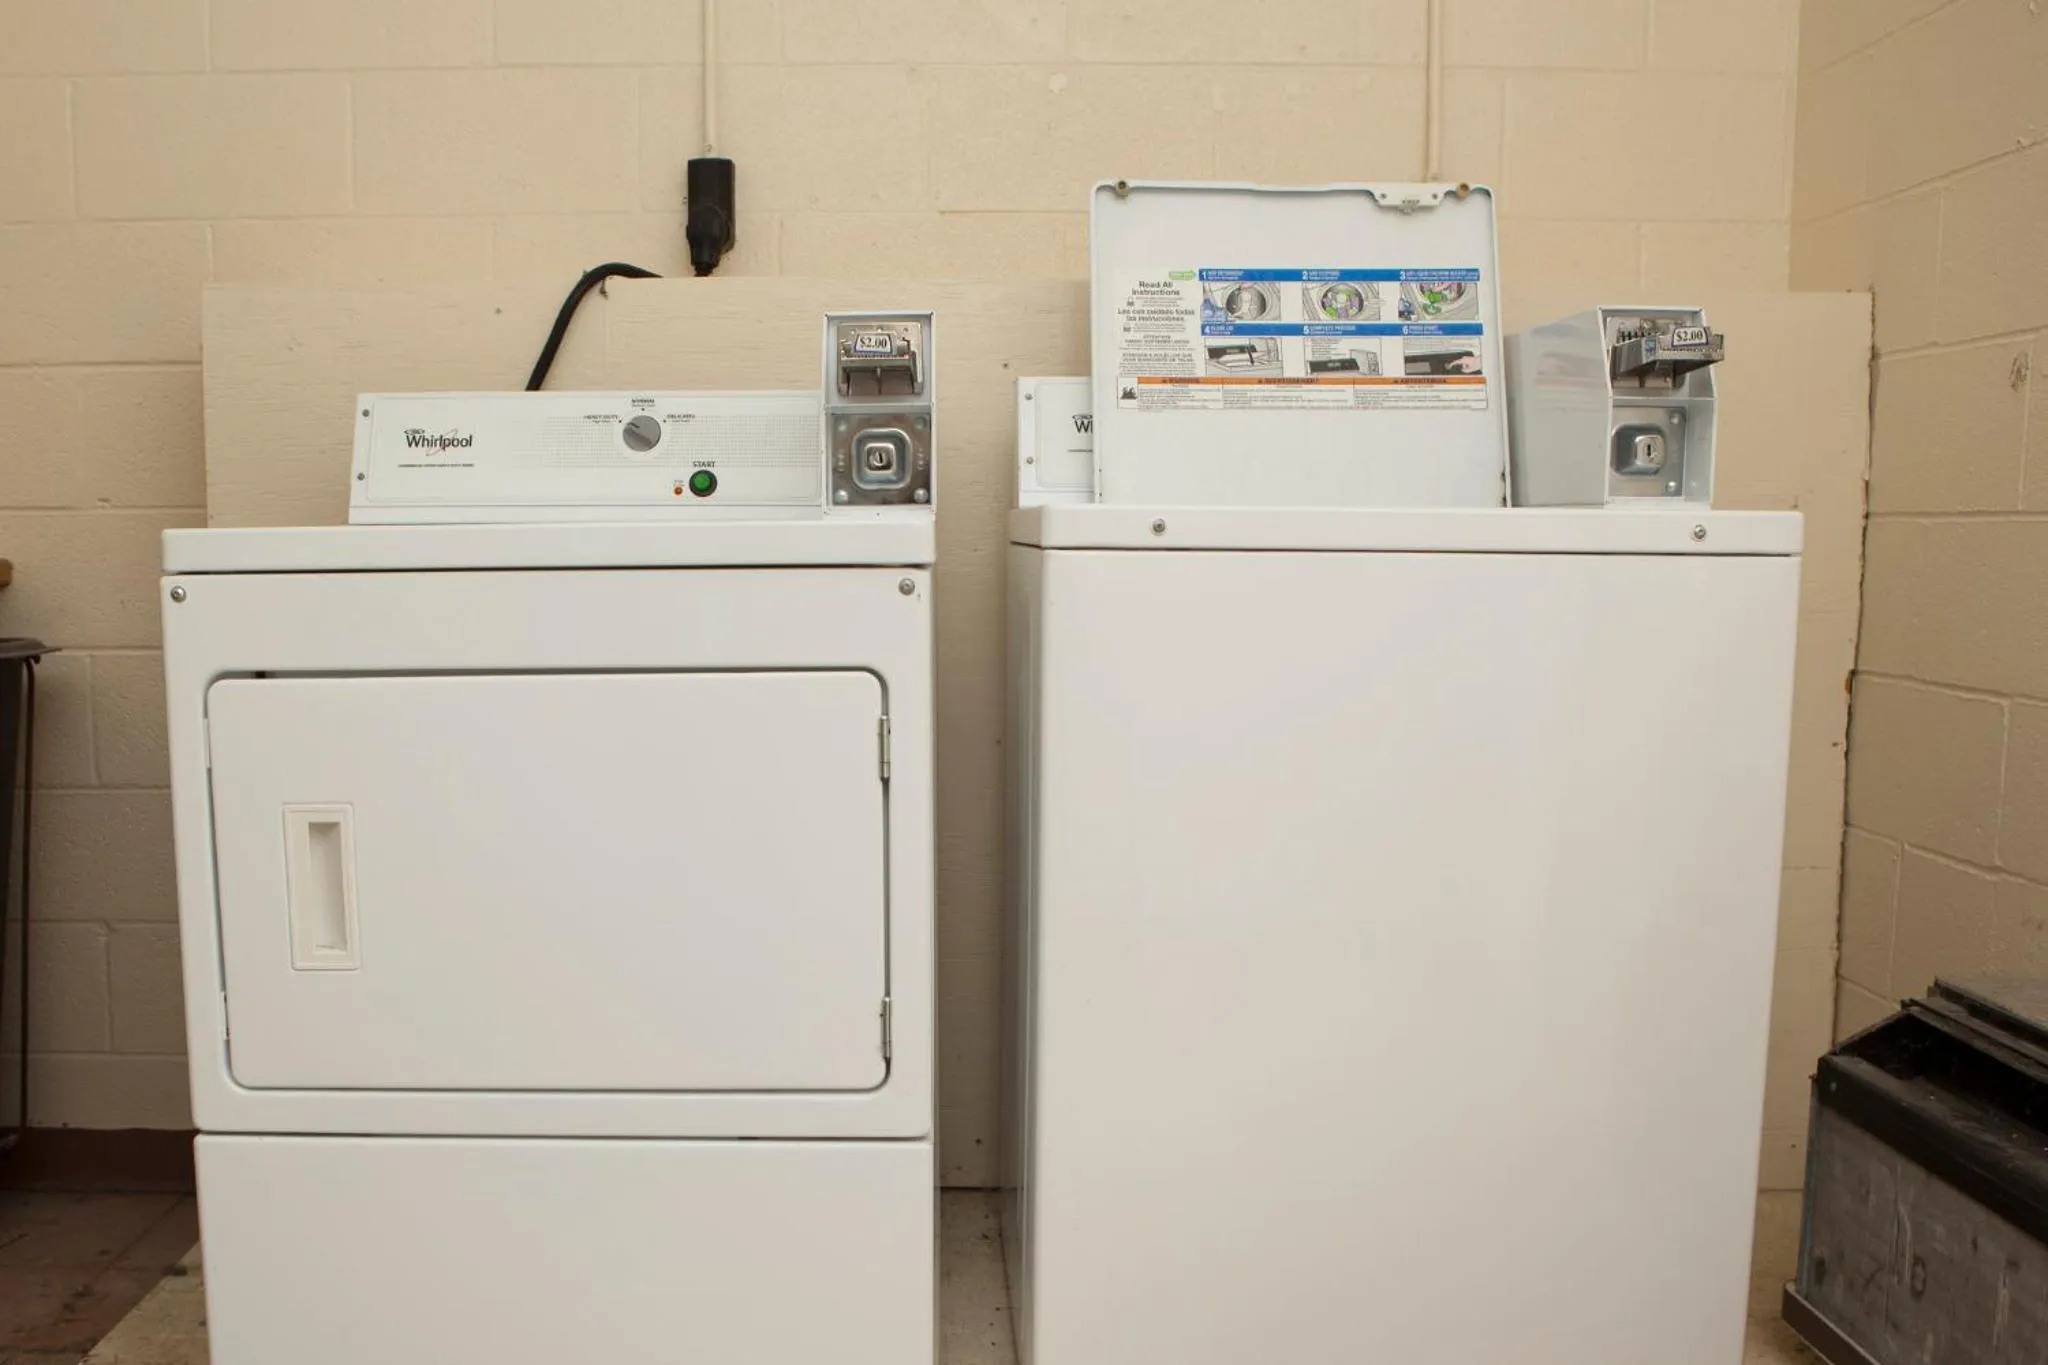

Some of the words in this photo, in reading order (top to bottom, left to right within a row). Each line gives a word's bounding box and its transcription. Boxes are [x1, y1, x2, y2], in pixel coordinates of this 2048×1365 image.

[1202, 271, 1207, 279] 1
[1302, 271, 1308, 280] 2
[1400, 271, 1406, 280] 3
[1203, 325, 1210, 334] 4
[1303, 326, 1309, 335] 5
[1402, 326, 1409, 335] 6
[1675, 330, 1704, 342] $2.00
[859, 336, 888, 349] $2.00
[406, 434, 473, 451] Whirlpool
